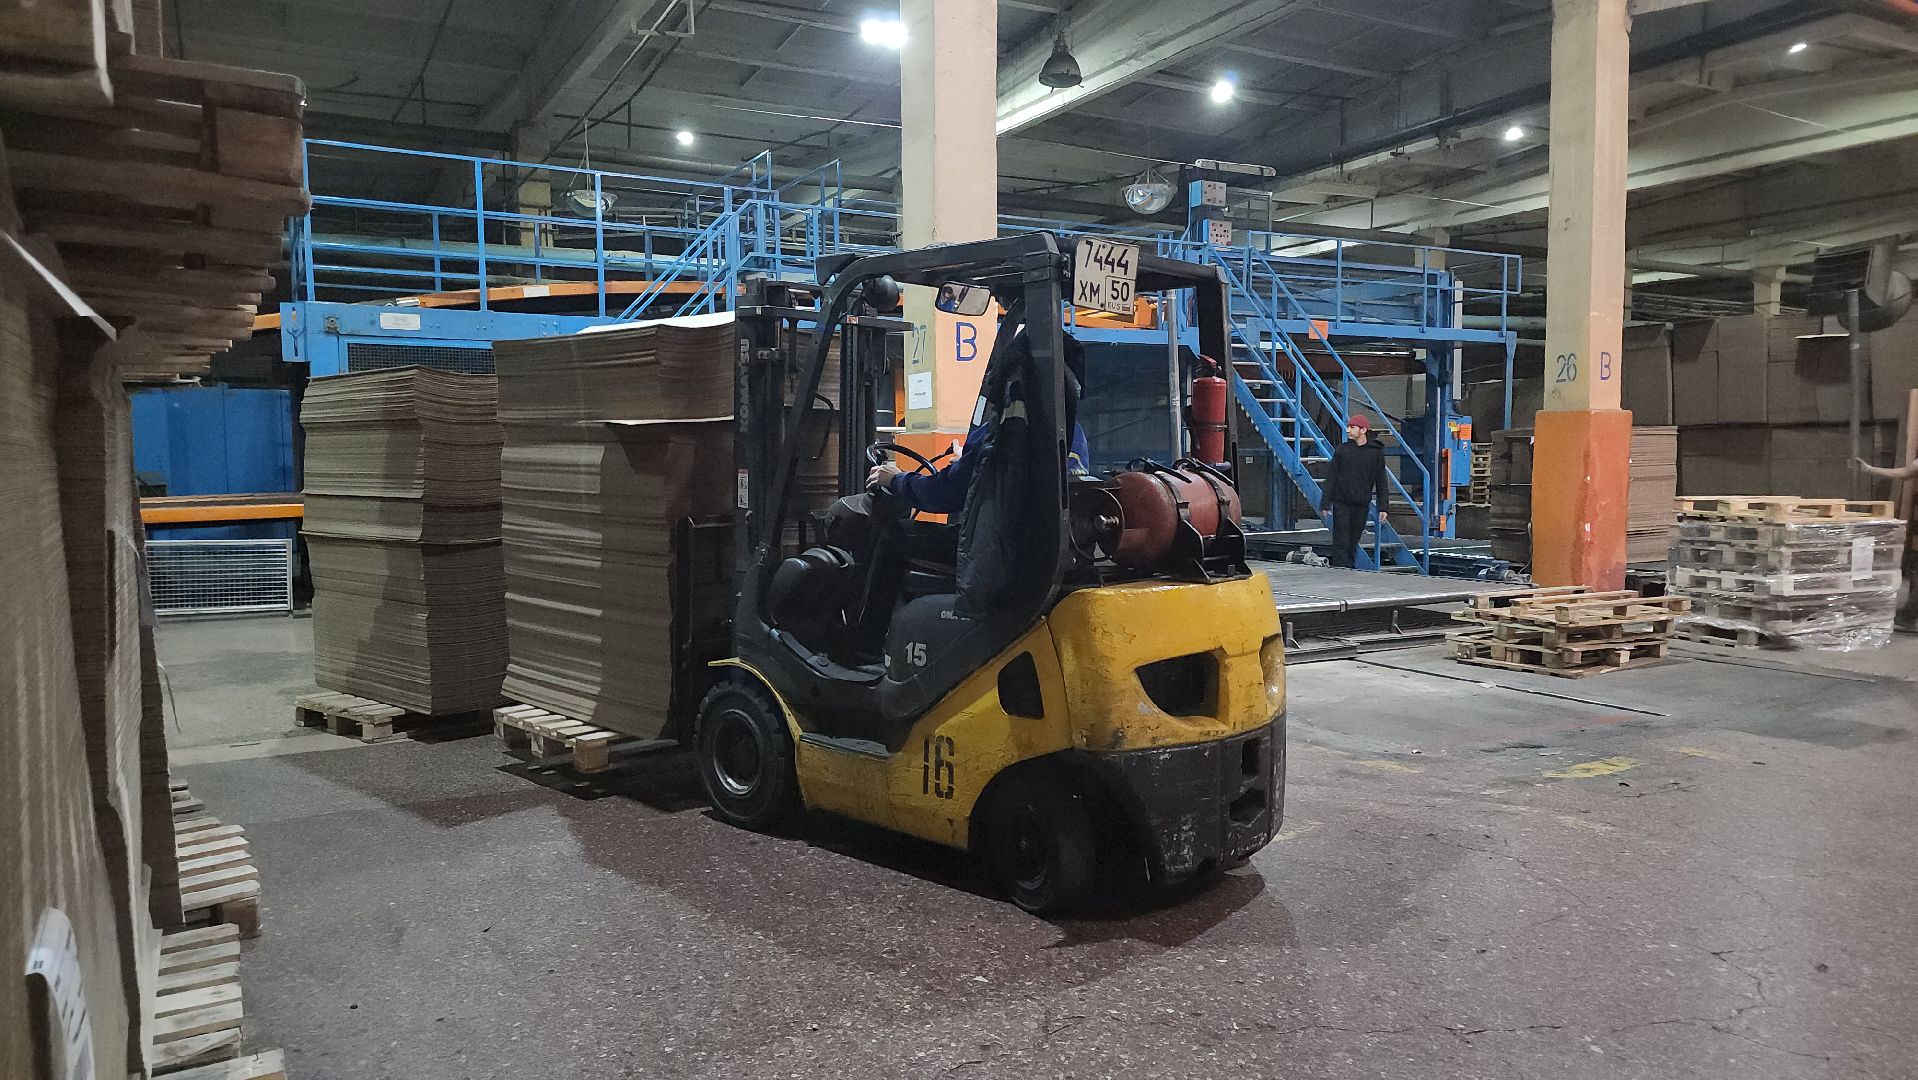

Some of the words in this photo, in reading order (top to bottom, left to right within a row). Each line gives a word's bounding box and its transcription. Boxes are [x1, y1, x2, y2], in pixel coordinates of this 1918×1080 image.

[1085, 240, 1129, 275] 7444
[1111, 280, 1129, 302] 50
[1107, 302, 1120, 310] RUS
[1556, 353, 1577, 383] 26
[905, 642, 927, 667] 15
[923, 735, 955, 799] 16
